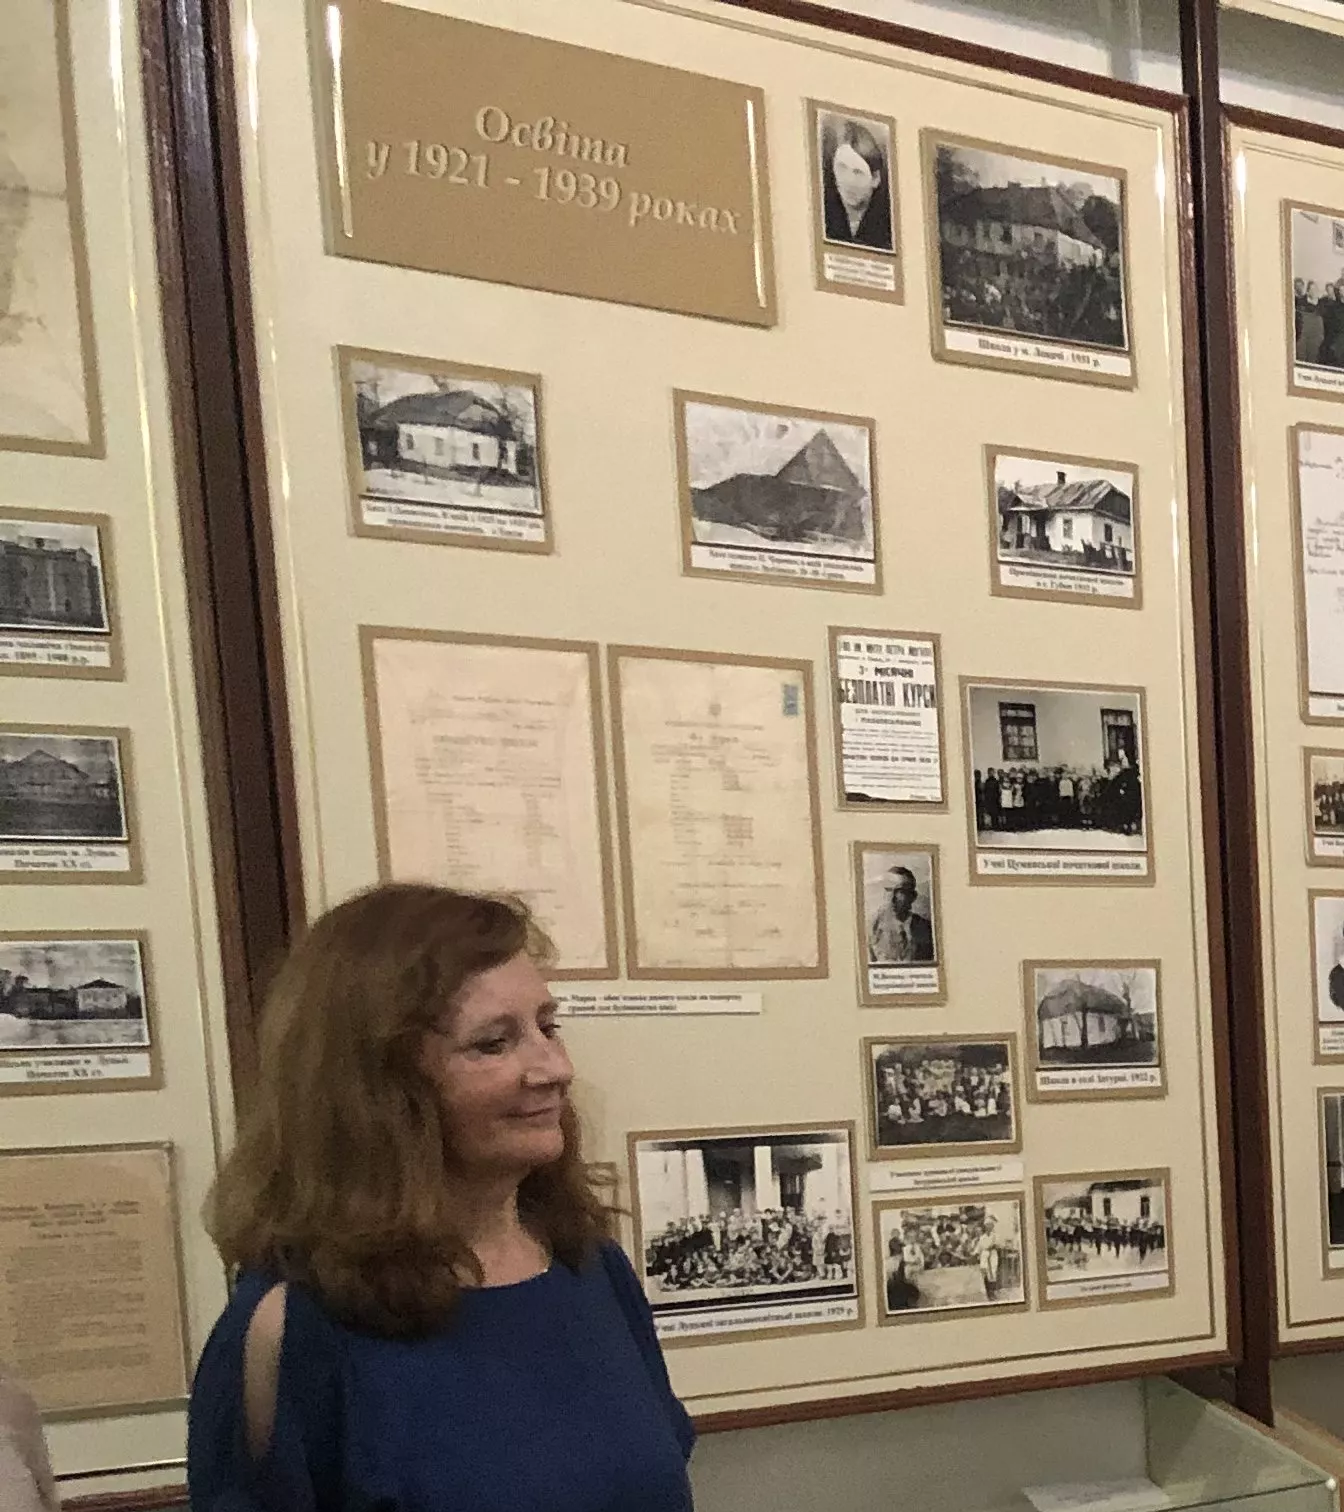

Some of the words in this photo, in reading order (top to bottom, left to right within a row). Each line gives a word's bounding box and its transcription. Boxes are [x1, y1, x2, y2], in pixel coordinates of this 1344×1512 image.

[476, 106, 631, 169] Освіта
[366, 140, 391, 180] у
[404, 140, 490, 188] 1921
[533, 166, 622, 212] 1939
[628, 190, 744, 235] роках
